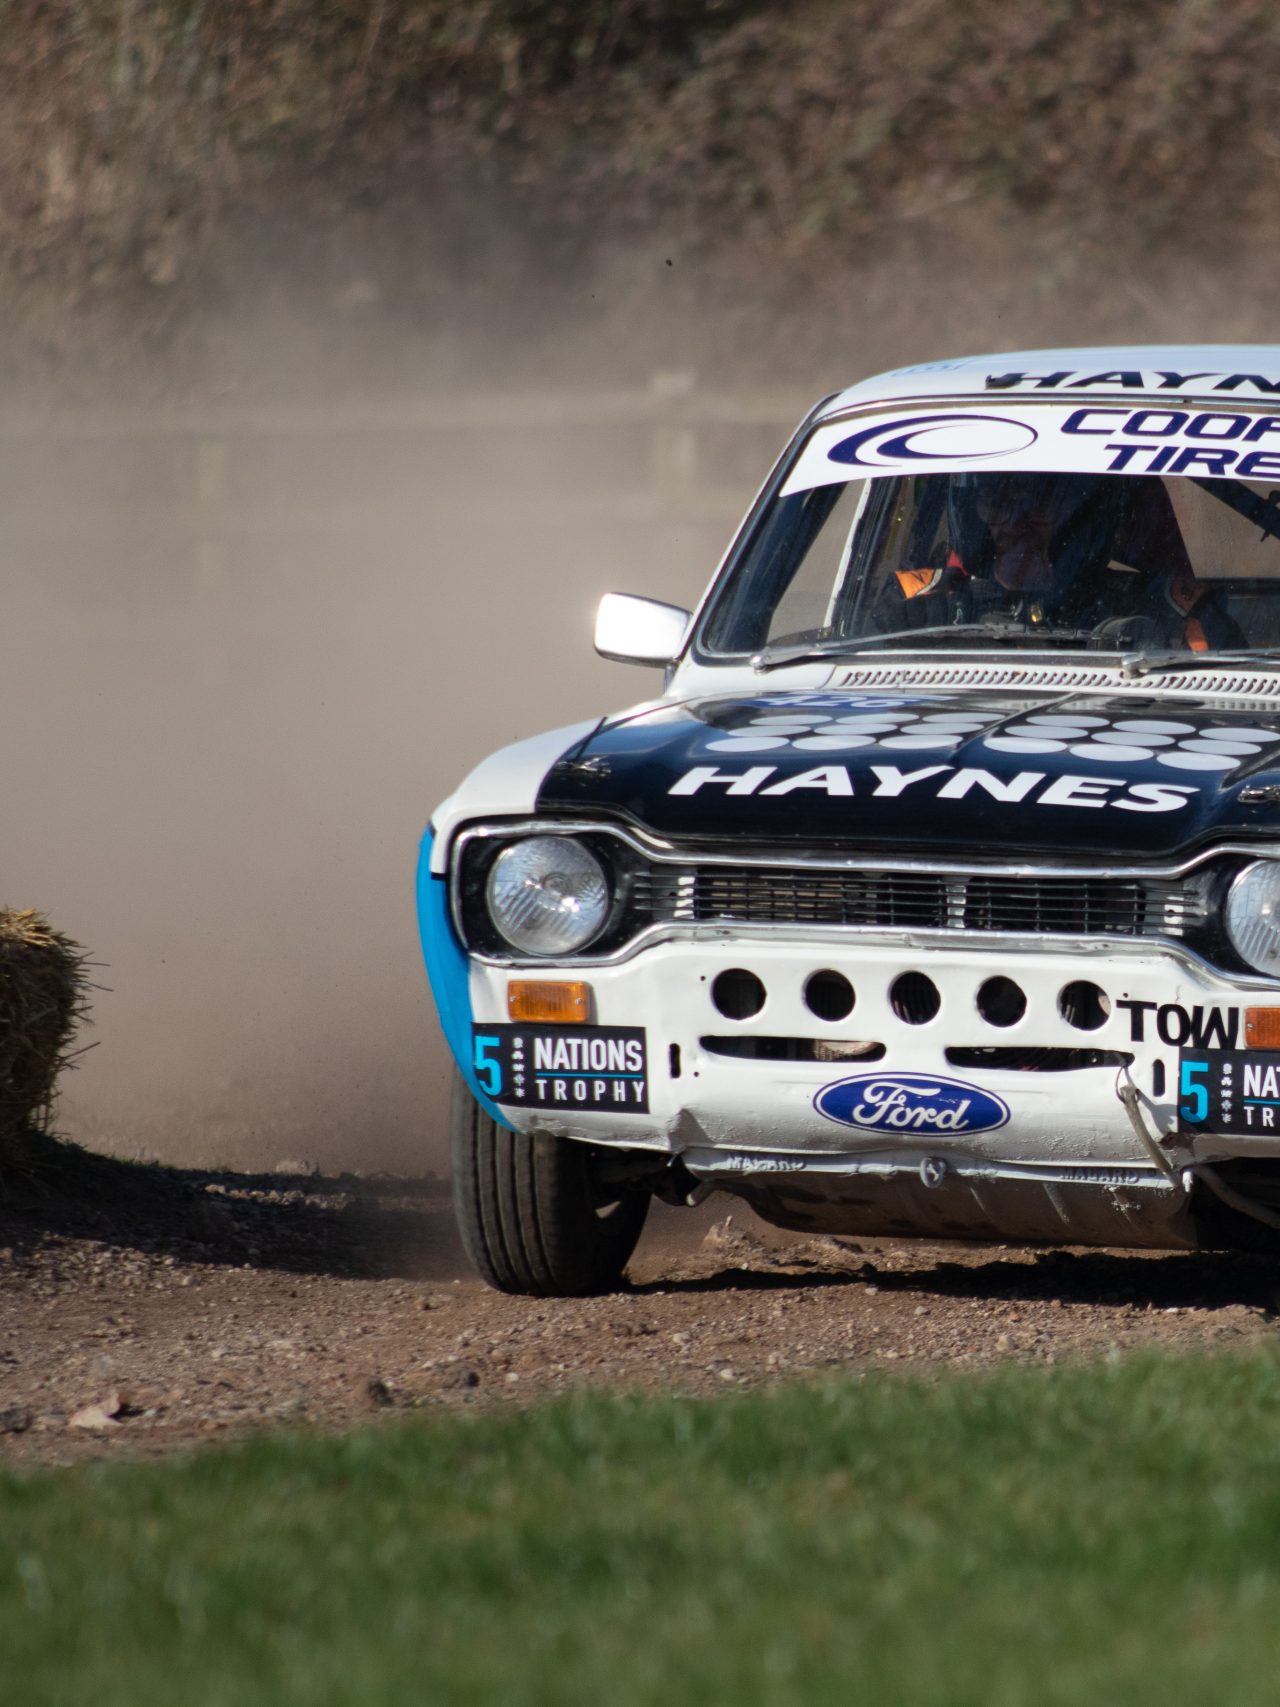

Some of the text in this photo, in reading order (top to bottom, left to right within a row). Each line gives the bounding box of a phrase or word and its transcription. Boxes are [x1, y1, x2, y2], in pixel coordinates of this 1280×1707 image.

[668, 766, 1200, 812] HAYNES
[1117, 1000, 1239, 1050] TOW
[474, 1034, 503, 1097] 5
[533, 1037, 644, 1072] NATIONS
[535, 1079, 645, 1103] TROPHY
[852, 1081, 971, 1130] Ford
[1179, 1060, 1209, 1124] 5
